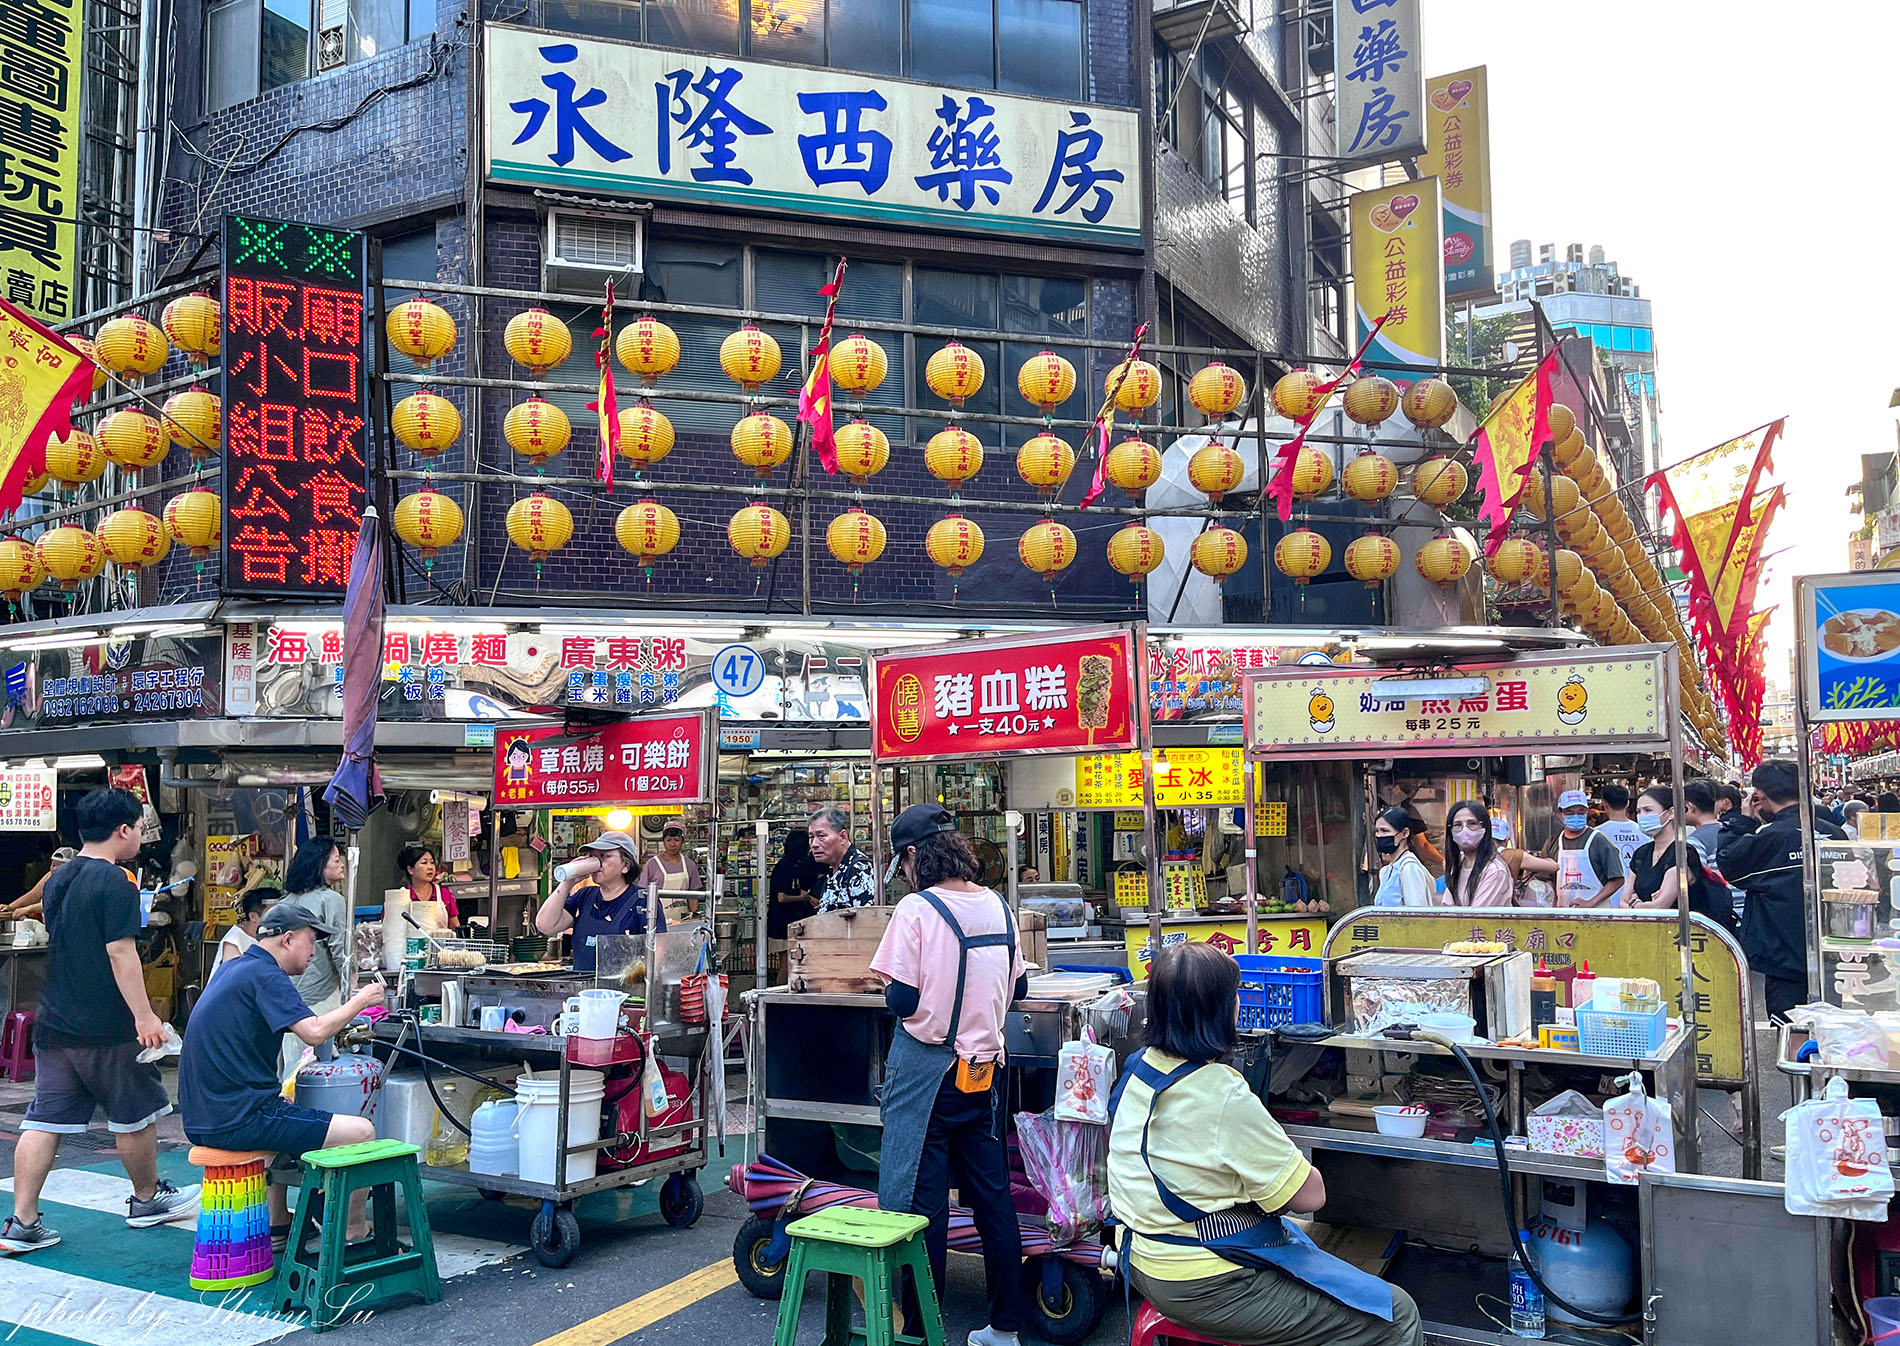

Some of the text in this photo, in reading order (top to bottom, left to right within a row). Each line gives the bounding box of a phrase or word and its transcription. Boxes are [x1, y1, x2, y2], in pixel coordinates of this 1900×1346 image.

[509, 43, 1125, 225] 永隆西藥房
[1442, 114, 1464, 190] 公益彩券
[0, 266, 68, 318] 賣店
[1384, 236, 1409, 327] 公益彩券
[228, 276, 298, 583] 販小組公告
[231, 623, 253, 703] 基隆廟口
[560, 636, 686, 671] 廣東粥
[722, 654, 755, 687] 47
[568, 672, 679, 687] 皮蛋瘦肉粥
[568, 687, 679, 703] 玉米雞肉粥
[934, 663, 1068, 719] 豬血糕
[135, 690, 202, 712] 24267304
[726, 735, 751, 744] 1950
[964, 714, 1039, 736] 一支40元
[1196, 792, 1213, 800] 35
[446, 802, 468, 861] 點餐區
[1038, 812, 1049, 854] 藥房
[1613, 833, 1640, 842] TENNIS
[1512, 1283, 1523, 1294] PH
